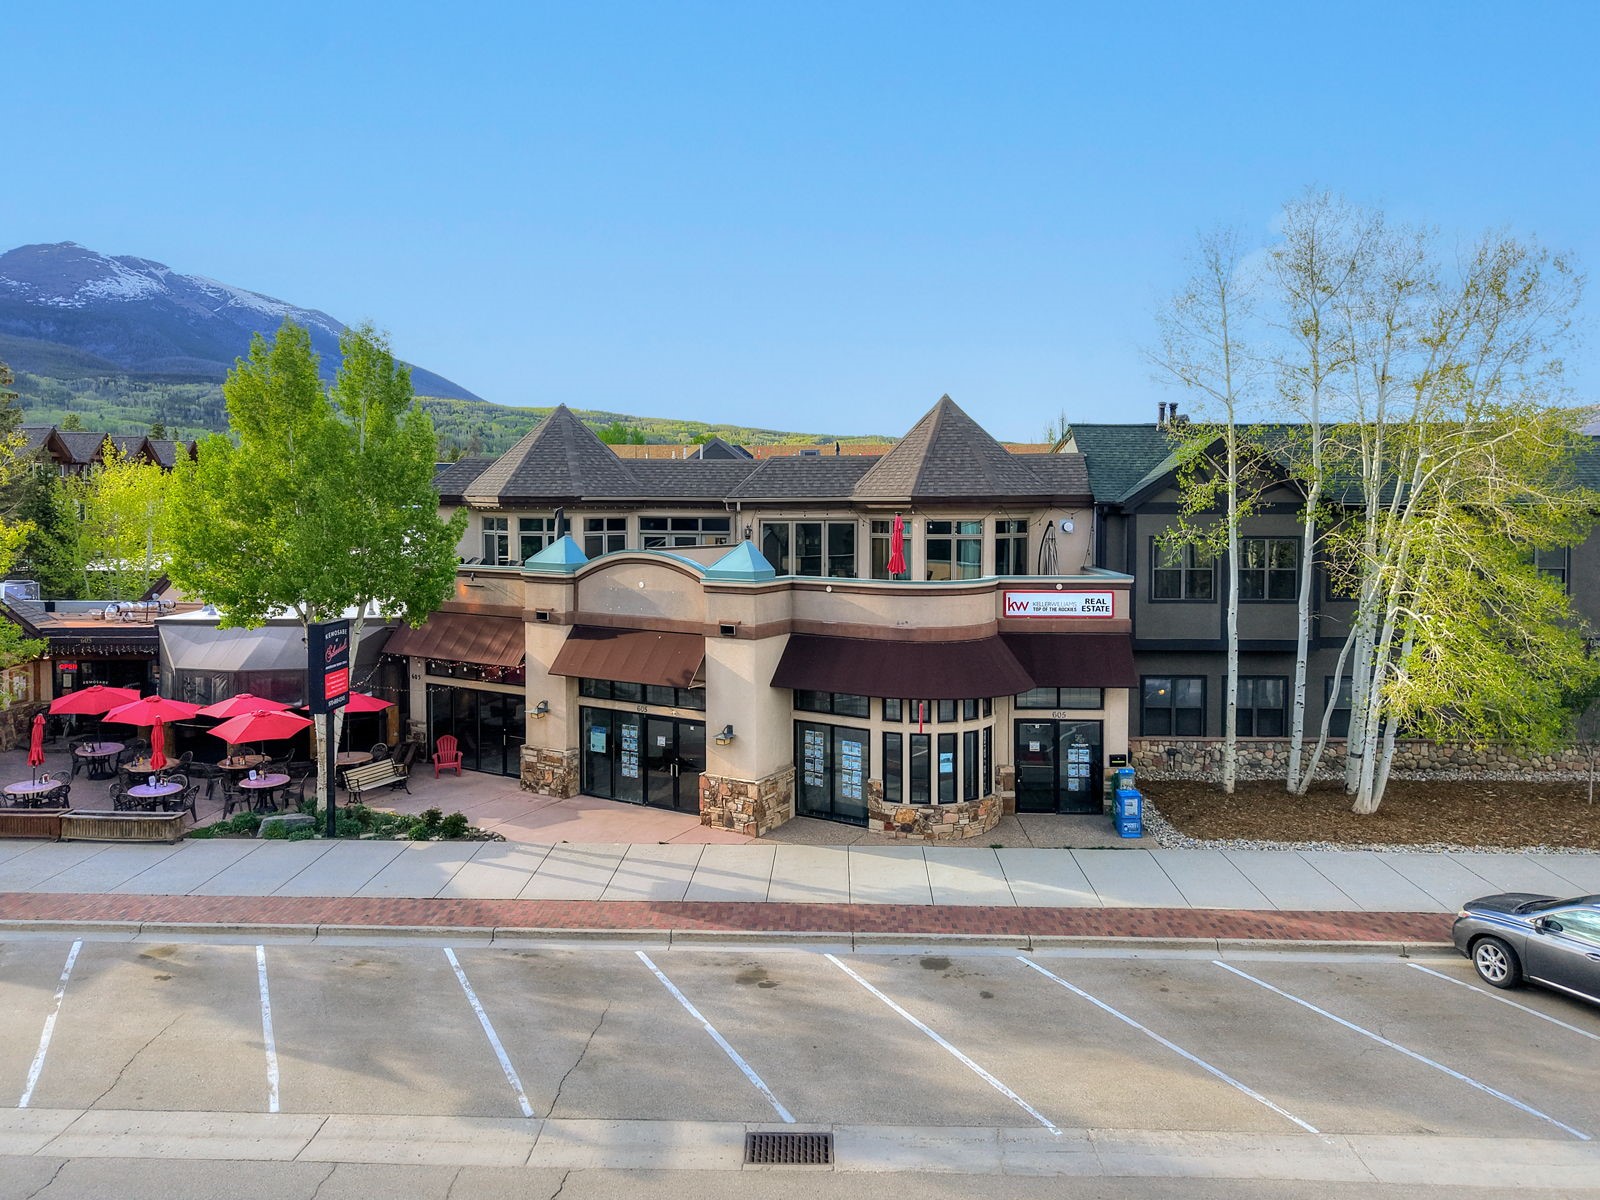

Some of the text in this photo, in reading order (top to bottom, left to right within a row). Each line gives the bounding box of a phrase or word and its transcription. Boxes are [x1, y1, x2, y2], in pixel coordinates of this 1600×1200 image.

[1008, 597, 1030, 611] kw
[1081, 605, 1110, 613] ESTATE
[325, 629, 348, 640] KEMOSABE
[637, 705, 648, 713] 605
[1052, 711, 1067, 719] 605
